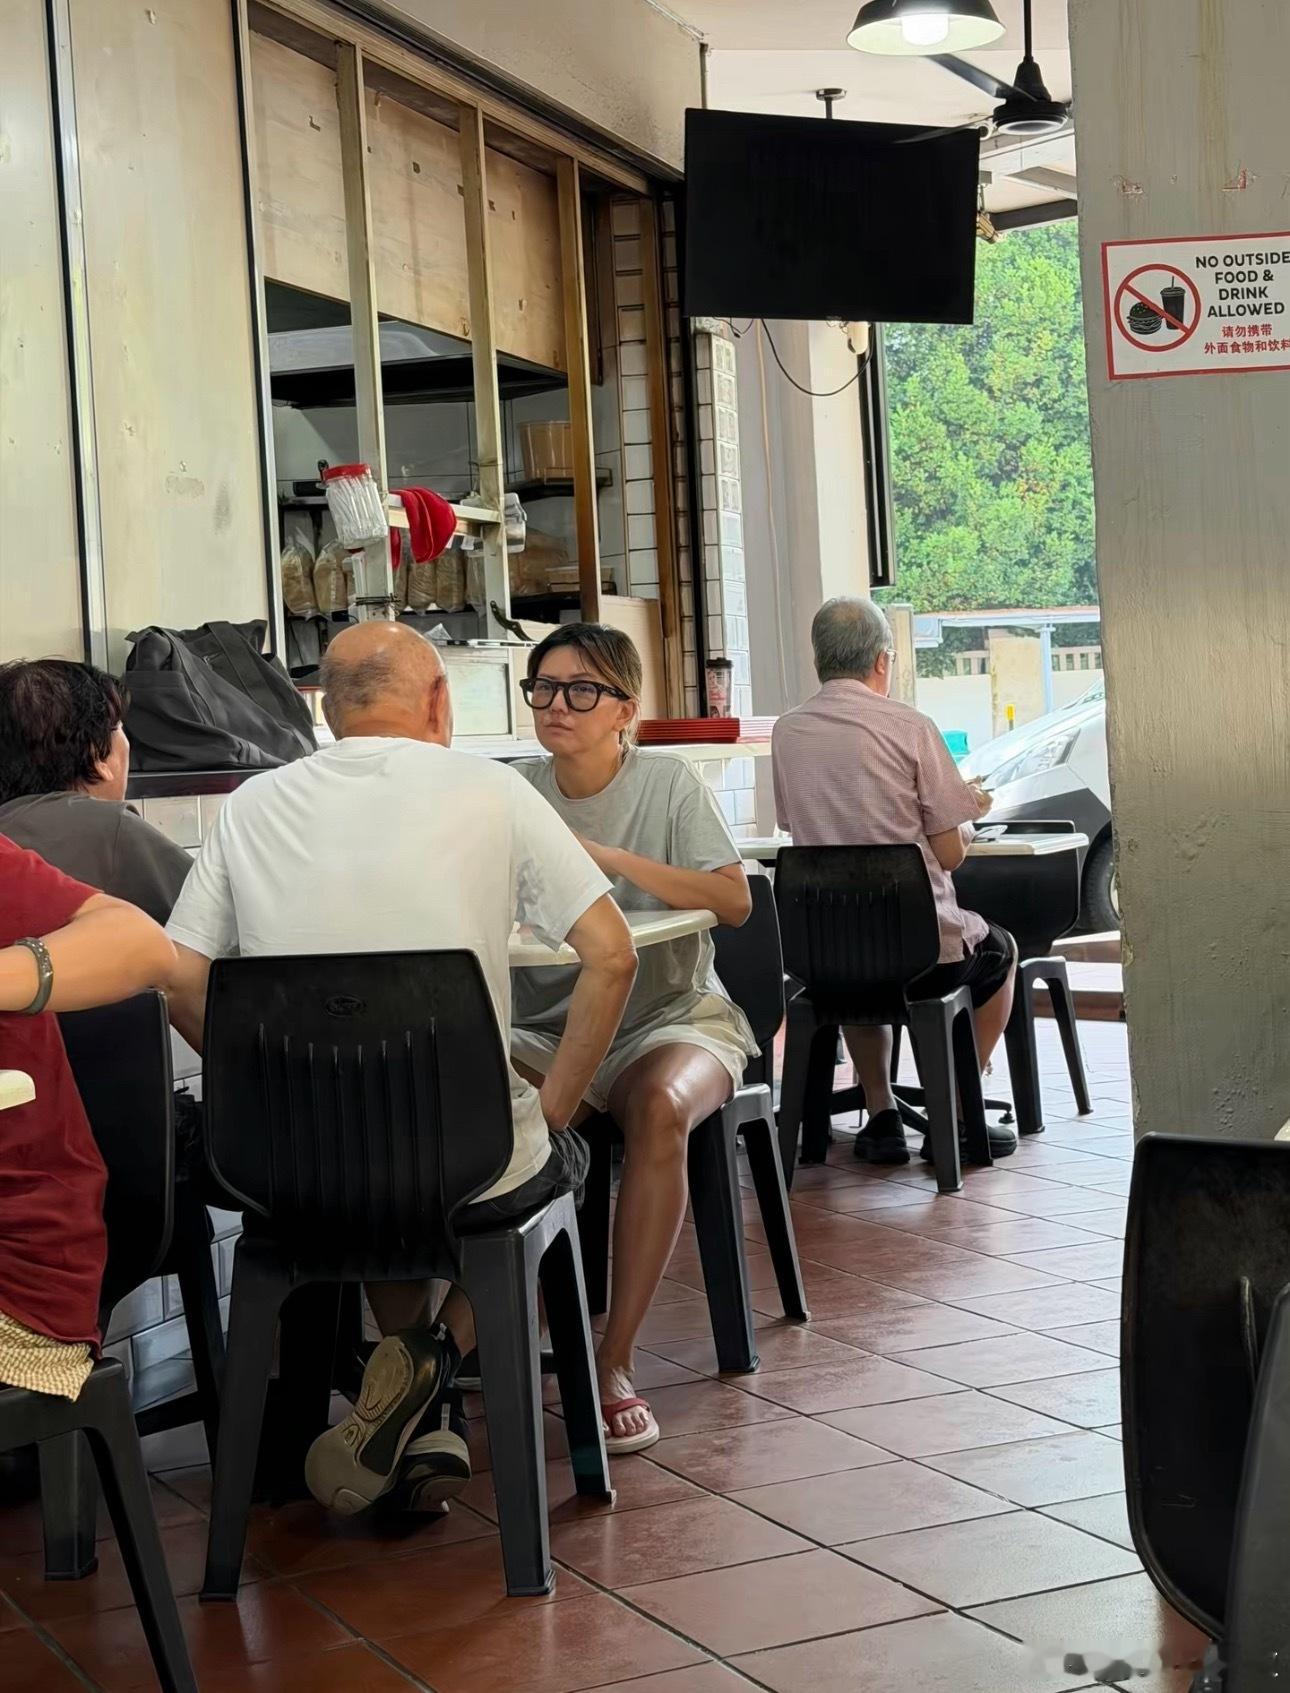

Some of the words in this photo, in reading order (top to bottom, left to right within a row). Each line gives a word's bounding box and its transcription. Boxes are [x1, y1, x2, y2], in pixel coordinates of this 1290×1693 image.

[1195, 256, 1219, 268] NO
[1223, 251, 1290, 267] OUTSIDE
[1215, 270, 1258, 284] FOOD
[1262, 269, 1274, 281] &
[1219, 286, 1268, 300] DRINK
[1207, 302, 1285, 318] ALLOWED
[1221, 323, 1273, 338] 请勿携带
[1204, 339, 1290, 354] 外面食物和饮料
